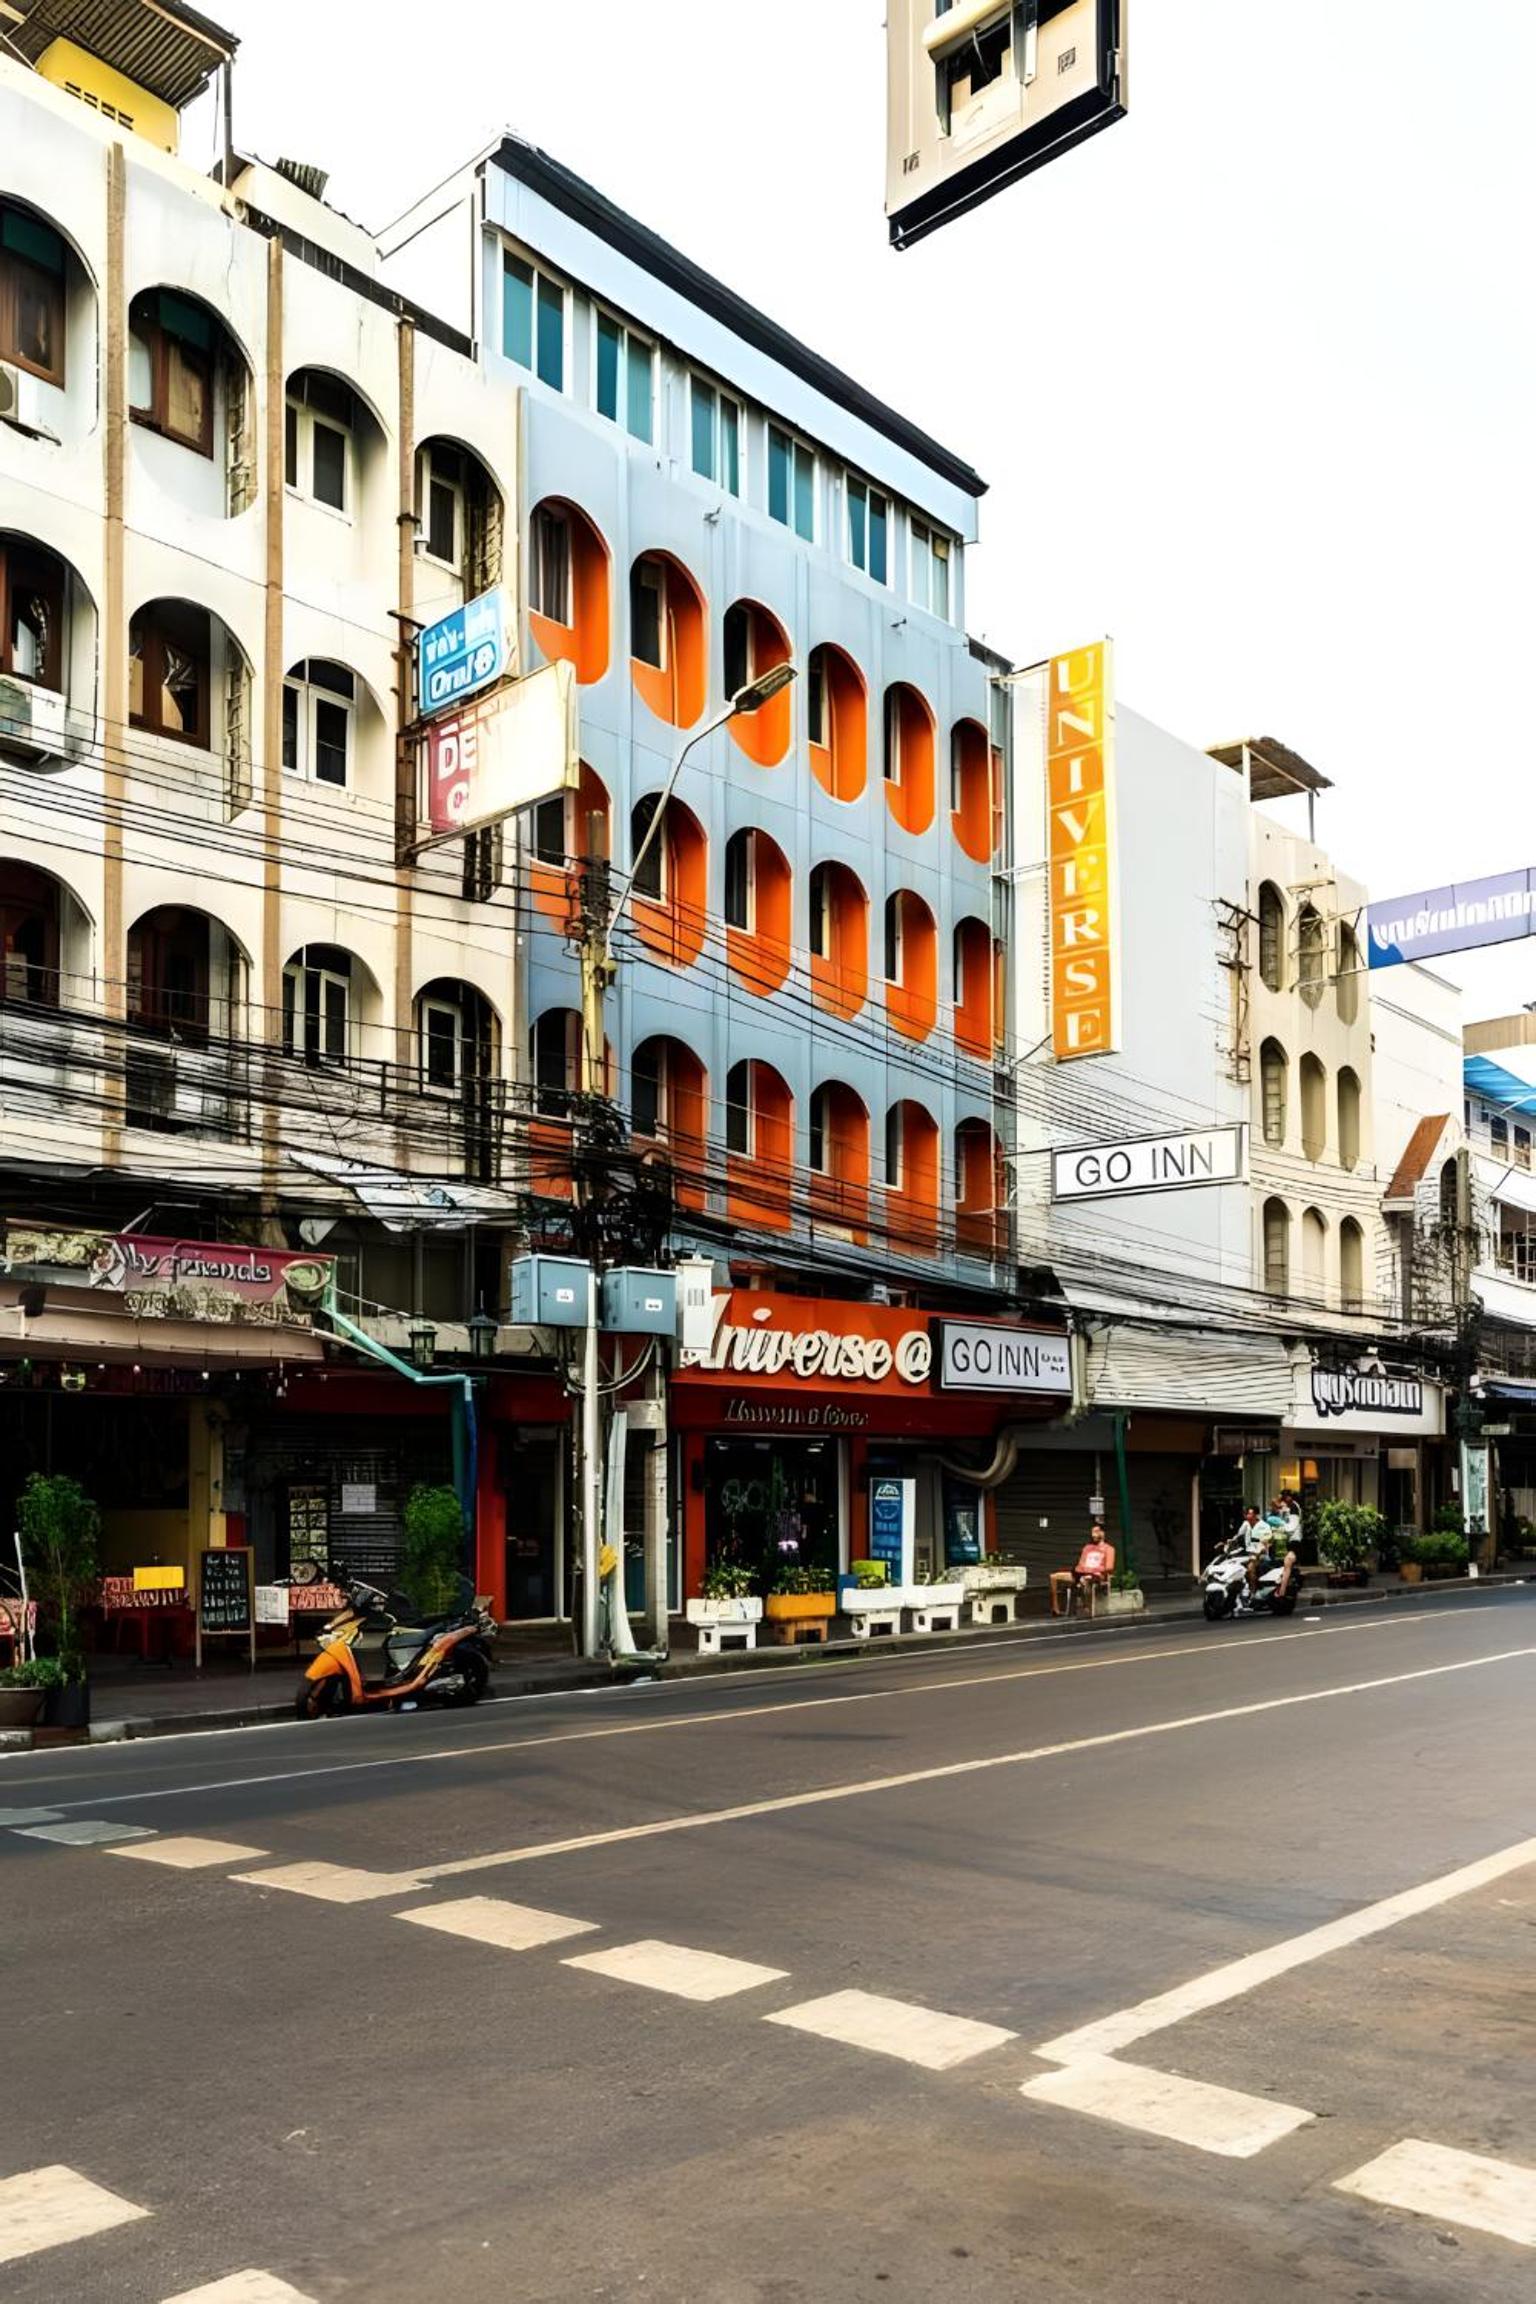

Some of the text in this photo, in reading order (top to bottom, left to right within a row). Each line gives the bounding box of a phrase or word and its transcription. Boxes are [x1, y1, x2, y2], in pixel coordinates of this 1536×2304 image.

[1056, 652, 1103, 1048] UNIVERSE
[1075, 1141, 1213, 1187] GO INN
[894, 1330, 932, 1384] @
[951, 1337, 991, 1373] GO
[998, 1343, 1039, 1377] INN
